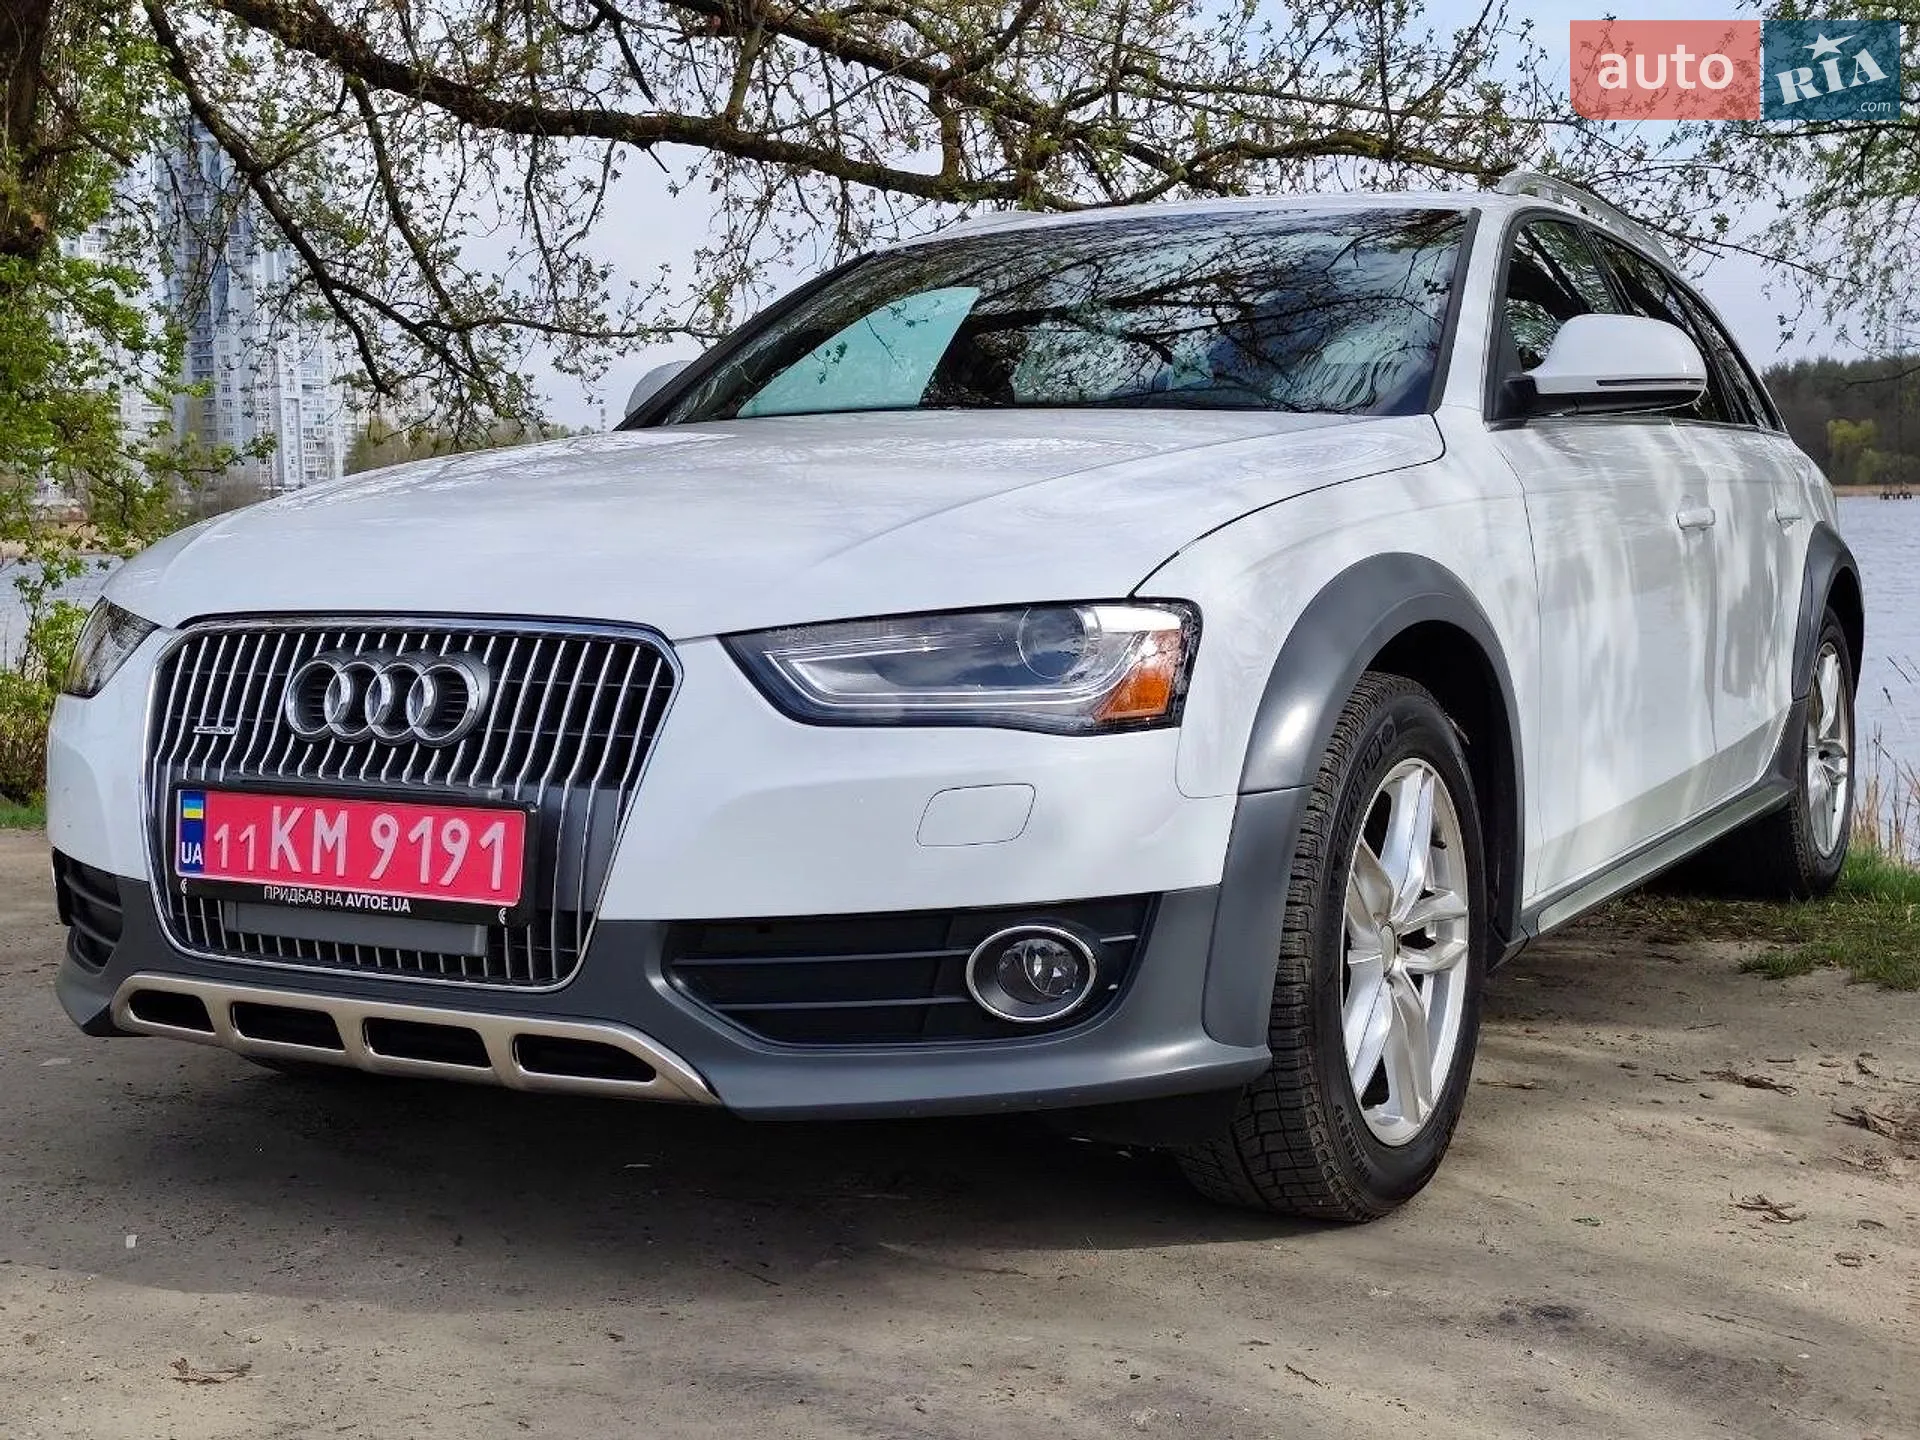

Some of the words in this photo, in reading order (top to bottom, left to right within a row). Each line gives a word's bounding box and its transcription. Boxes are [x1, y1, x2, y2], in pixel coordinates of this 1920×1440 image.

[181, 841, 203, 866] UA
[214, 823, 256, 872] 11
[270, 806, 349, 877] KM
[369, 813, 505, 890] 9191
[264, 885, 322, 905] ПРИДБАВ
[324, 891, 343, 907] НА
[346, 894, 411, 913] AVTOE.UA
